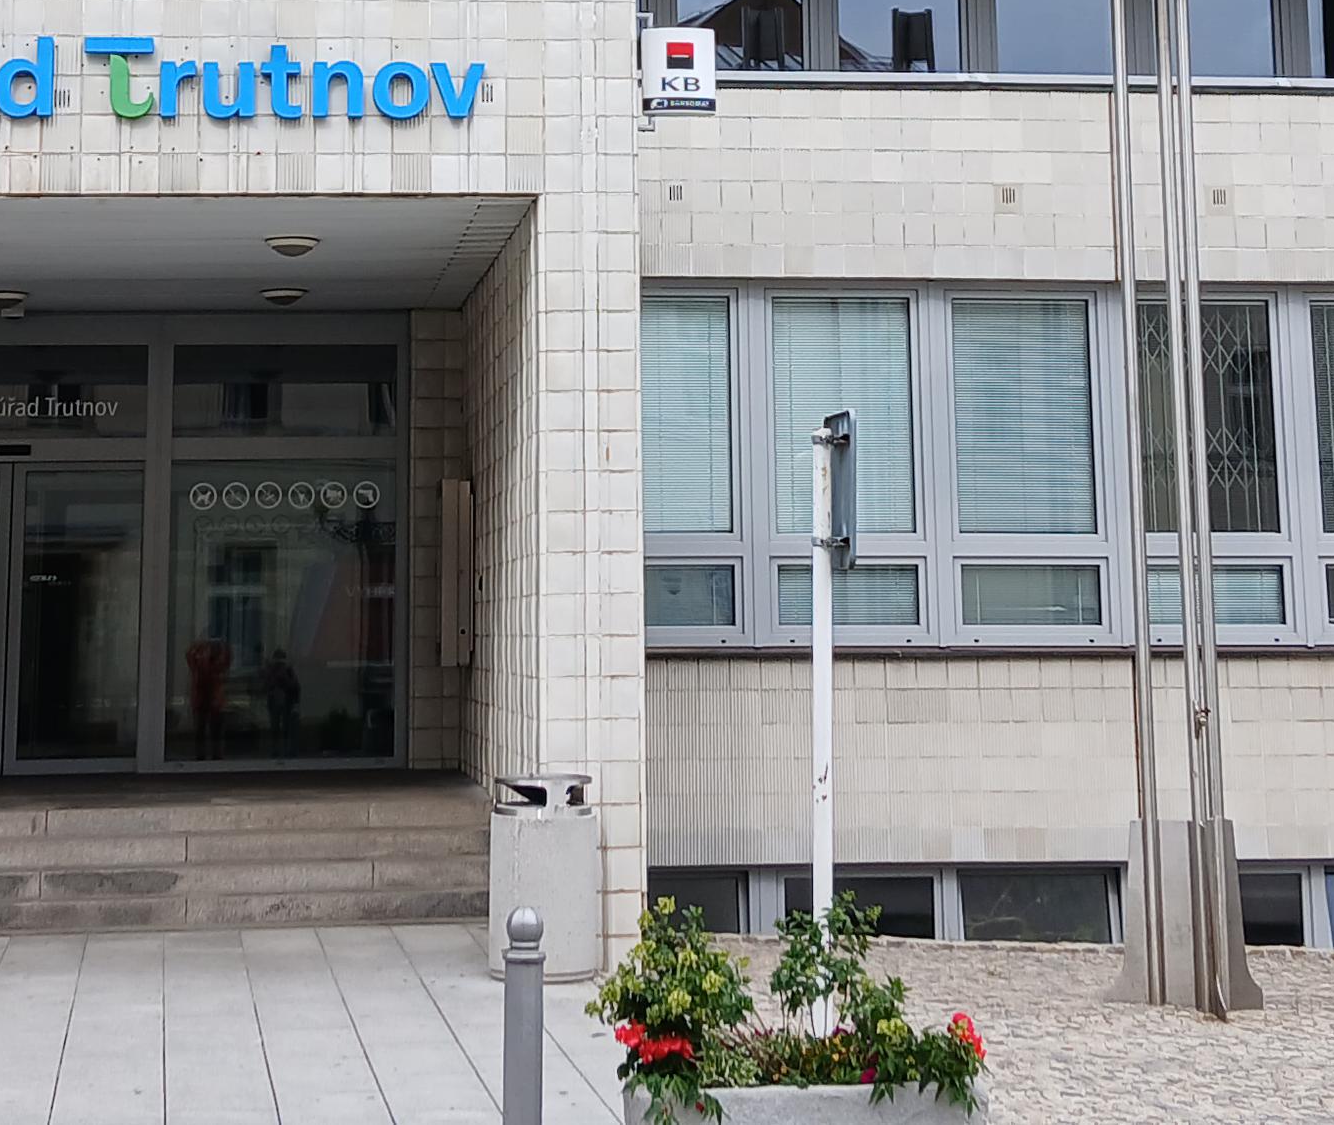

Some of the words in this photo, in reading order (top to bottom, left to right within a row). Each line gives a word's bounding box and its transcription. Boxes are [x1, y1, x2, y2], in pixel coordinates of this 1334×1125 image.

[84, 36, 485, 121] Trutnov
[661, 76, 701, 92] KB
[44, 397, 118, 417] Trutnov
